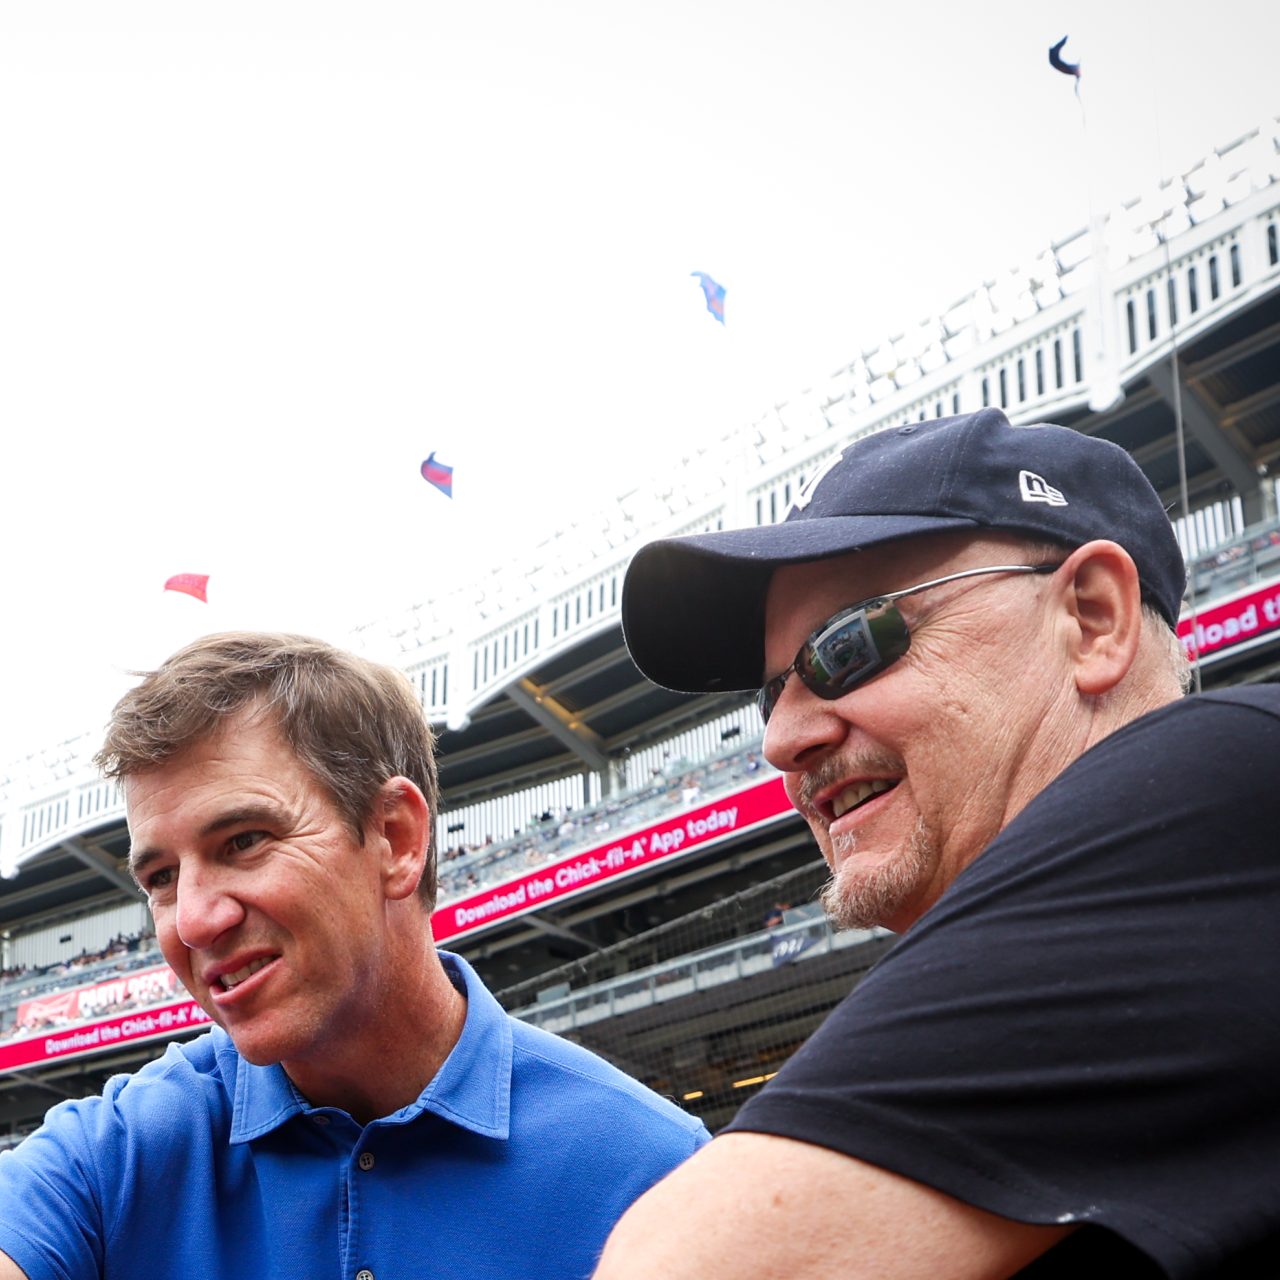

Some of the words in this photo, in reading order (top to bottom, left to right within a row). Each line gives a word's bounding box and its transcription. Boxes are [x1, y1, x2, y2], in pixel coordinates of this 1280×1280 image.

[455, 886, 526, 927] Download
[527, 878, 554, 898] the
[651, 826, 685, 853] App
[687, 806, 738, 840] today
[78, 980, 125, 1010] PARTY
[45, 1029, 99, 1054] Download
[100, 1024, 121, 1041] the
